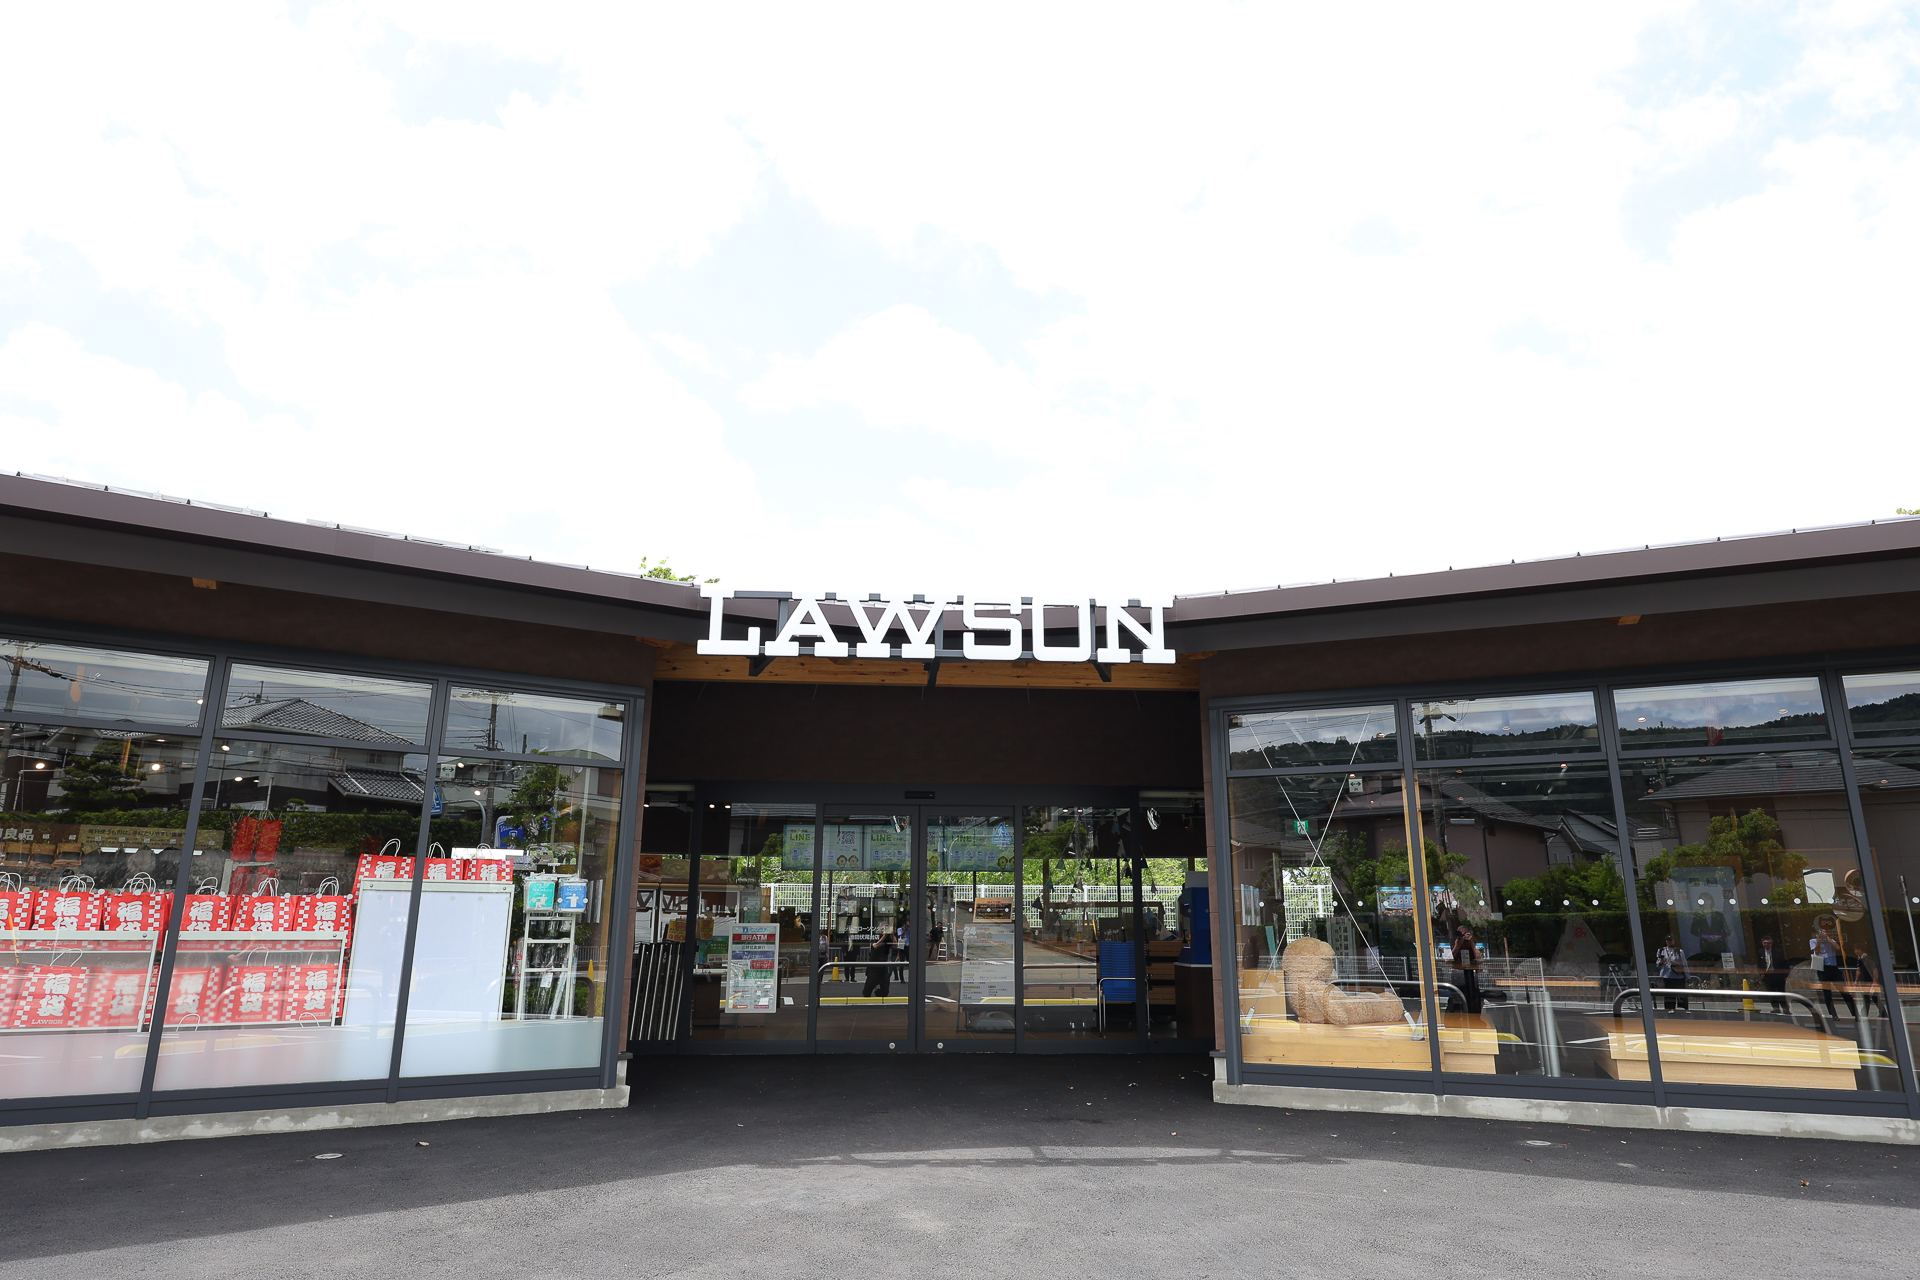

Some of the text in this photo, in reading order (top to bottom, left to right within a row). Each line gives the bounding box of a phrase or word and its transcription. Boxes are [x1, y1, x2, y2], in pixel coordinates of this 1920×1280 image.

[697, 582, 1177, 664] LAWSON
[0, 827, 35, 841] 良品
[789, 833, 811, 841] LINE
[871, 834, 892, 842] LINE
[963, 926, 977, 936] 24
[38, 973, 72, 1017] 福袋
[238, 972, 267, 1013] 福袋
[303, 970, 329, 1011] 福袋
